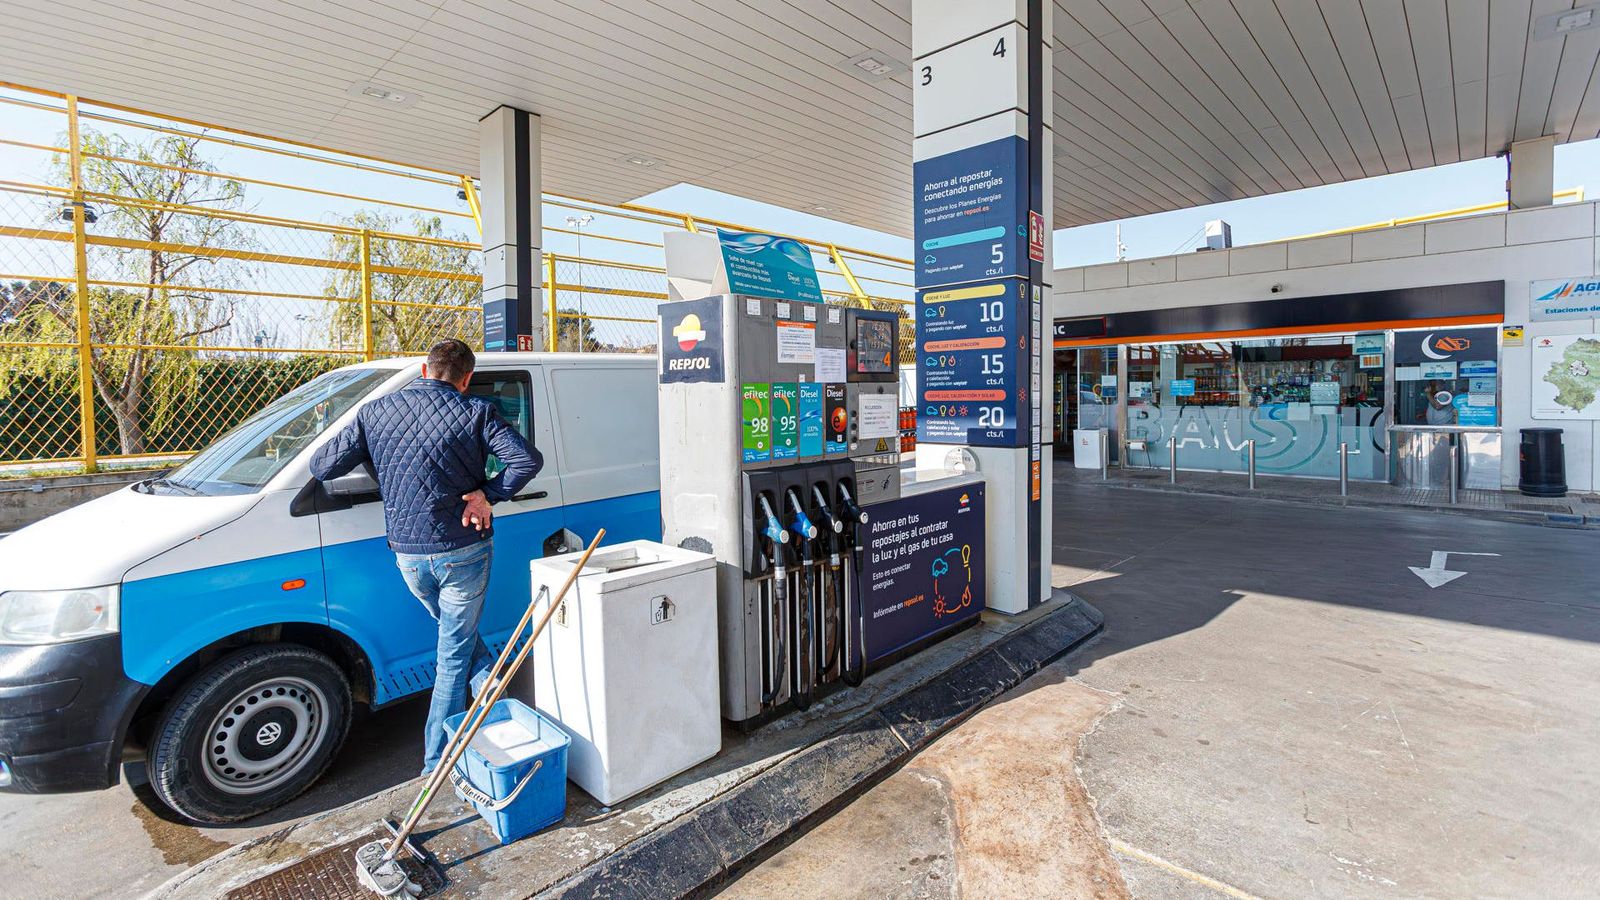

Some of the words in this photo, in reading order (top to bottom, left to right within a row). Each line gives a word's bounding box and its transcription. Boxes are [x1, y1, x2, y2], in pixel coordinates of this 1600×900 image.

[992, 37, 1006, 58] 4
[922, 66, 932, 86] 3
[924, 180, 949, 192] Ahorra
[950, 177, 958, 186] al
[959, 169, 992, 184] repostar
[924, 185, 968, 201] conectando
[969, 177, 1003, 191] energías
[924, 204, 949, 215] Descubre
[958, 198, 977, 208] Planes
[978, 193, 1002, 204] Energías
[924, 216, 936, 224] para
[937, 212, 956, 222] ahorrar
[964, 205, 990, 216] repsol.es
[991, 243, 1004, 264] 5
[986, 267, 1004, 276] cts./l
[980, 301, 1004, 322] 10
[1545, 306, 1588, 314] Estaciones
[986, 324, 1004, 333] cts./l
[669, 357, 711, 371] REPSOL
[882, 351, 890, 367] 4
[981, 354, 1004, 374] 15
[744, 390, 769, 399] efitec
[774, 389, 796, 398] efitec
[800, 390, 819, 398] Diesel
[826, 389, 844, 398] Diesel
[752, 417, 769, 434] 98
[780, 416, 796, 431] 95
[978, 406, 1004, 428] 20
[986, 430, 1004, 438] cts./l
[872, 519, 896, 534] Ahorra
[898, 518, 907, 526] en
[908, 513, 920, 524] tus
[872, 530, 910, 548] repostajes
[910, 527, 918, 538] al
[918, 520, 948, 536] contratar
[872, 552, 880, 564] la
[881, 548, 892, 561] luz
[893, 548, 898, 560] y
[900, 545, 907, 556] el
[908, 541, 920, 555] gas
[921, 538, 930, 548] de
[931, 536, 938, 546] tu
[939, 532, 954, 544] casa
[872, 572, 884, 581] Esto
[891, 562, 912, 574] conectar
[872, 578, 895, 592] energías.
[873, 604, 896, 619] Infórmate
[898, 602, 904, 610] en
